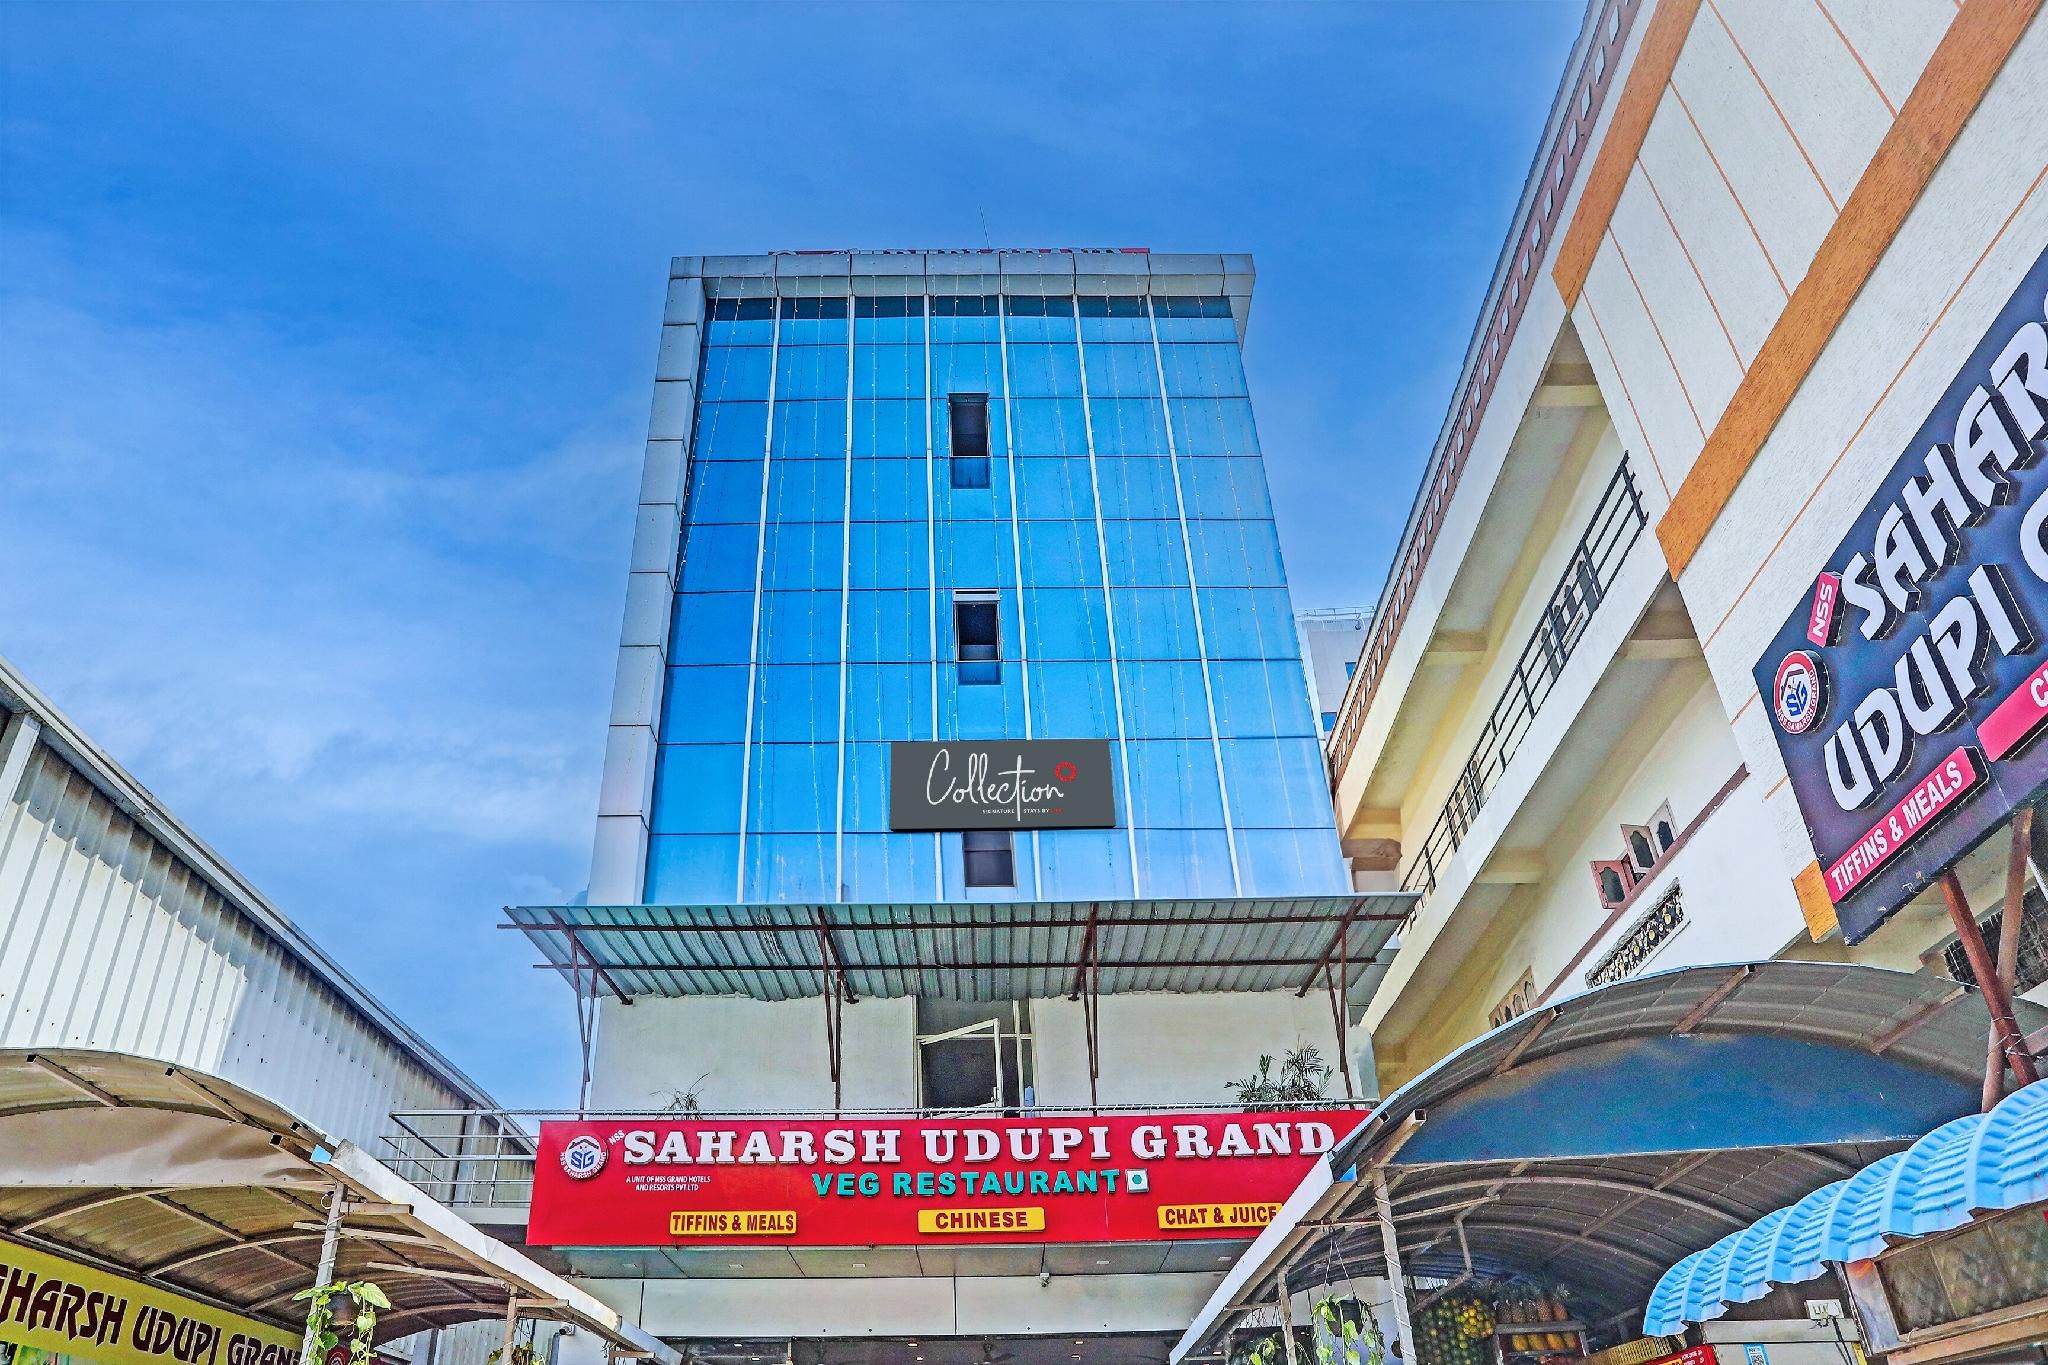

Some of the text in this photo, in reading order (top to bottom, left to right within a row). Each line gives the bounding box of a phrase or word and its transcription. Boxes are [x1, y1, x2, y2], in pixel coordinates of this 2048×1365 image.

[1842, 290, 2048, 641] SAHAR
[1812, 583, 1832, 638] NSS
[1824, 564, 2020, 811] UDUPI
[927, 749, 1064, 821] Collection
[1831, 760, 1962, 892] TIFFINS & MEALS
[608, 1129, 625, 1145] NSS
[623, 1121, 1335, 1165] SAHARSH UDUPI GRAND
[570, 1150, 593, 1170] SG
[811, 1169, 1120, 1197] VEG RESTAURANT
[672, 1213, 795, 1232] TIFFINS & MEALS
[935, 1211, 1029, 1229] CHINESE
[1165, 1208, 1208, 1226] CHAT
[1213, 1207, 1223, 1223] &
[0, 1263, 128, 1348] HARSH
[132, 1304, 222, 1365] UDUPI
